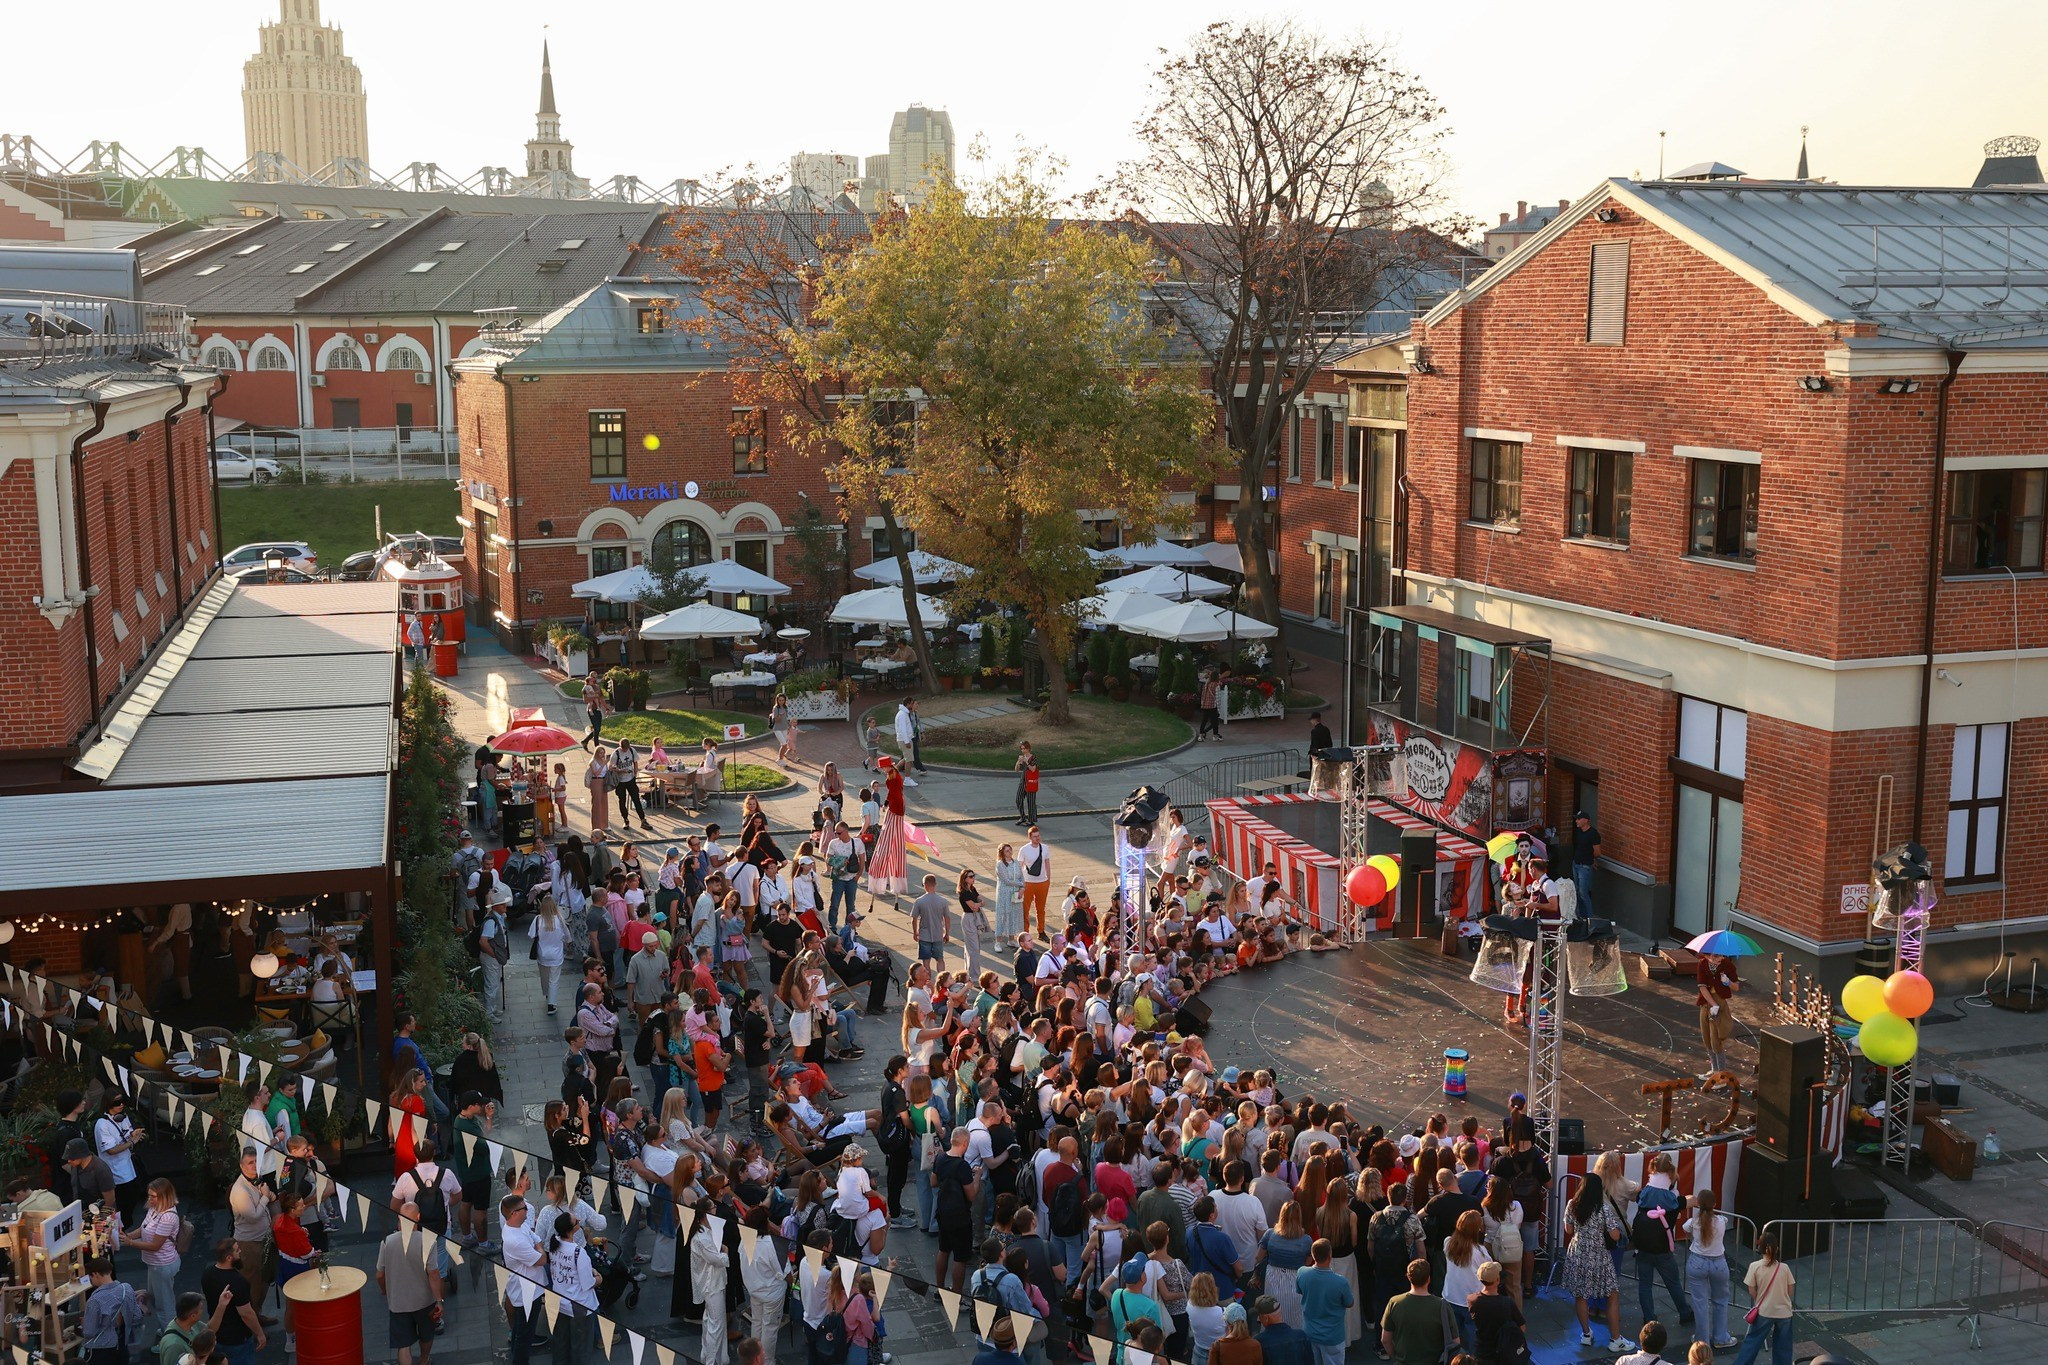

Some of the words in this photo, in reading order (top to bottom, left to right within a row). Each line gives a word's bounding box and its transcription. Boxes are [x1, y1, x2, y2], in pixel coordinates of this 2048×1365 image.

[609, 481, 678, 501] Meraki
[705, 479, 738, 489] GREEK
[707, 489, 750, 499] TAVERNA
[1405, 743, 1444, 771] MOSCOW
